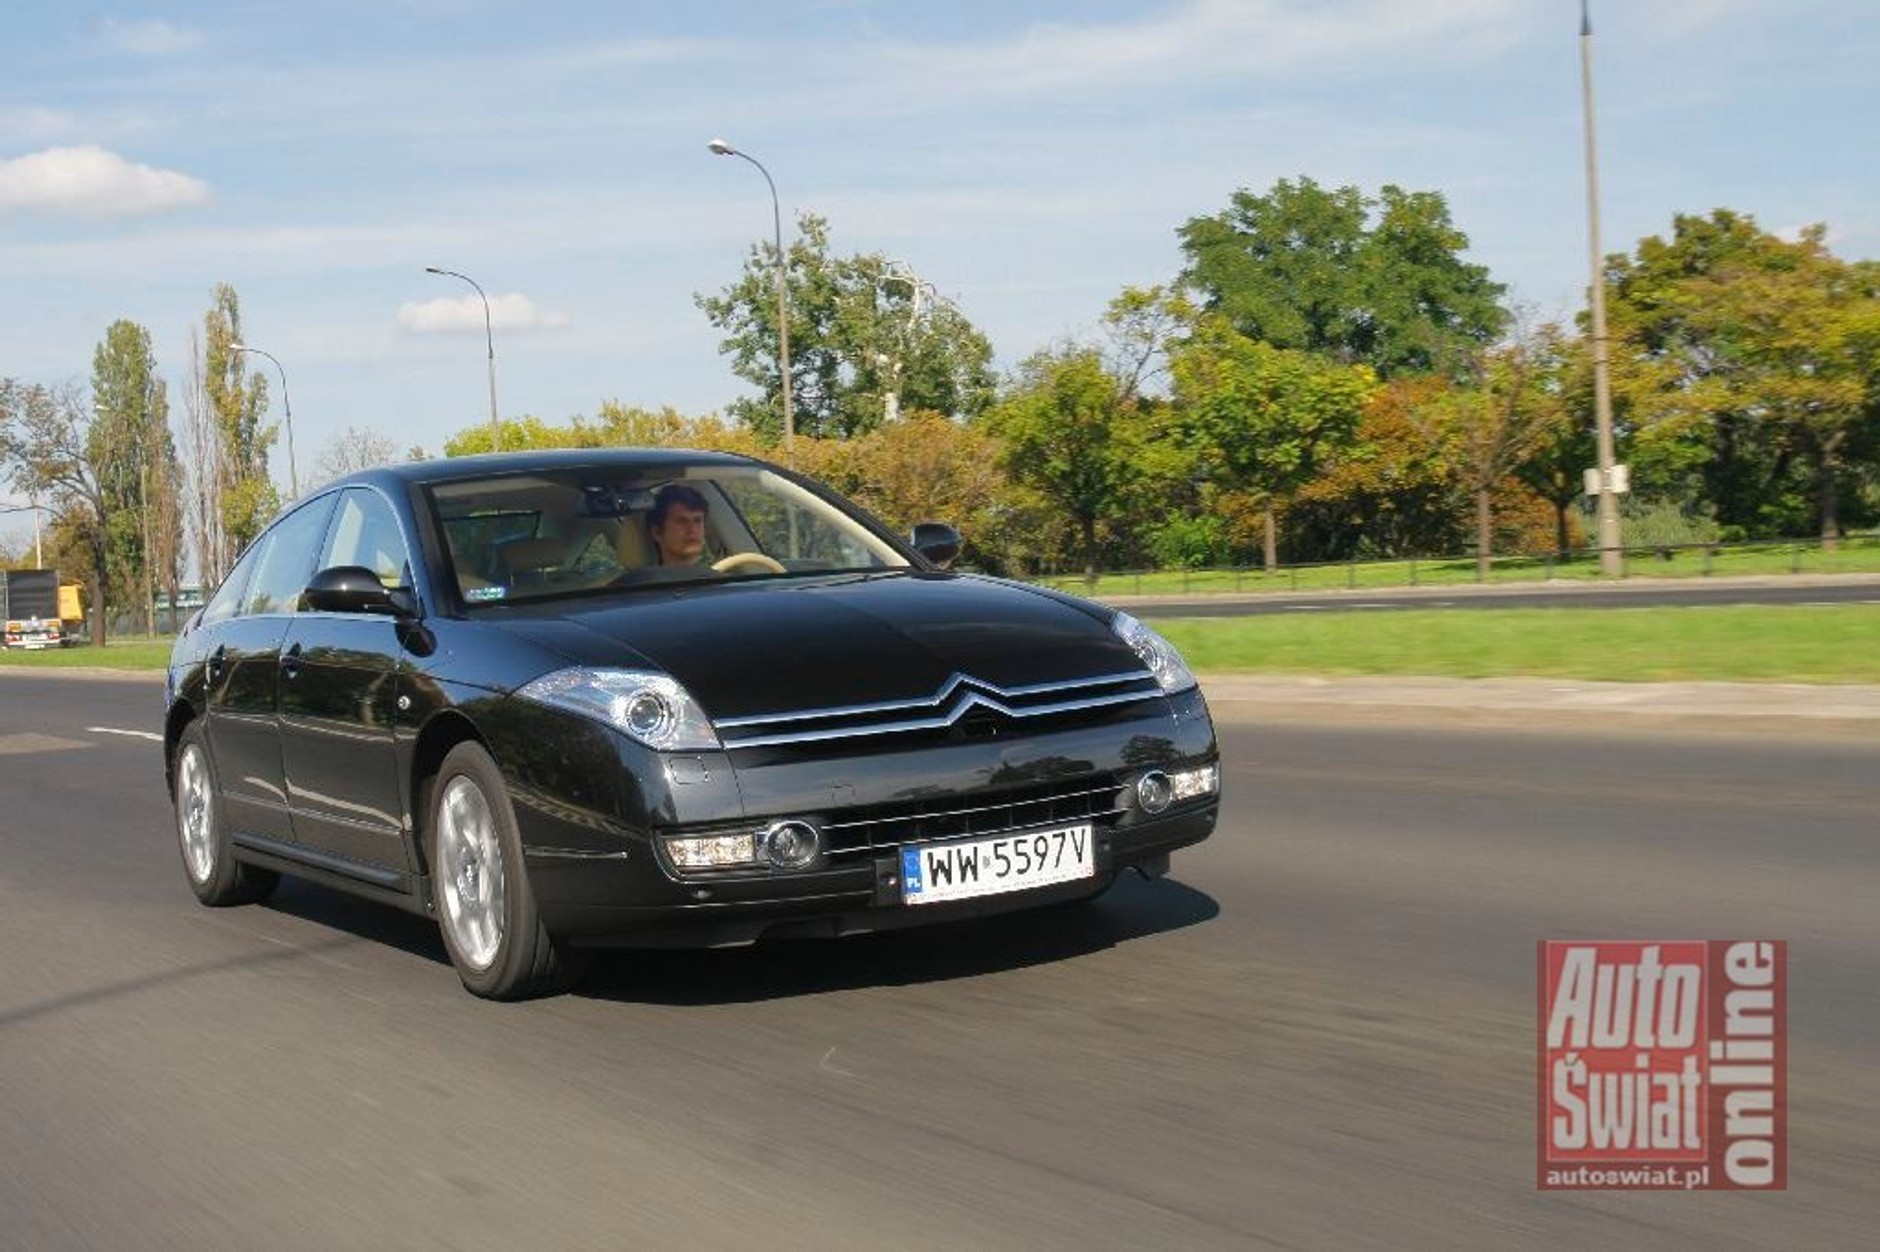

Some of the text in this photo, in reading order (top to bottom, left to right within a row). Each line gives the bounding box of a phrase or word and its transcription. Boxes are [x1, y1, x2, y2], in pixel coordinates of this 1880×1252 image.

[927, 846, 979, 887] WW
[993, 829, 1086, 877] 5597V
[907, 877, 921, 888] PL
